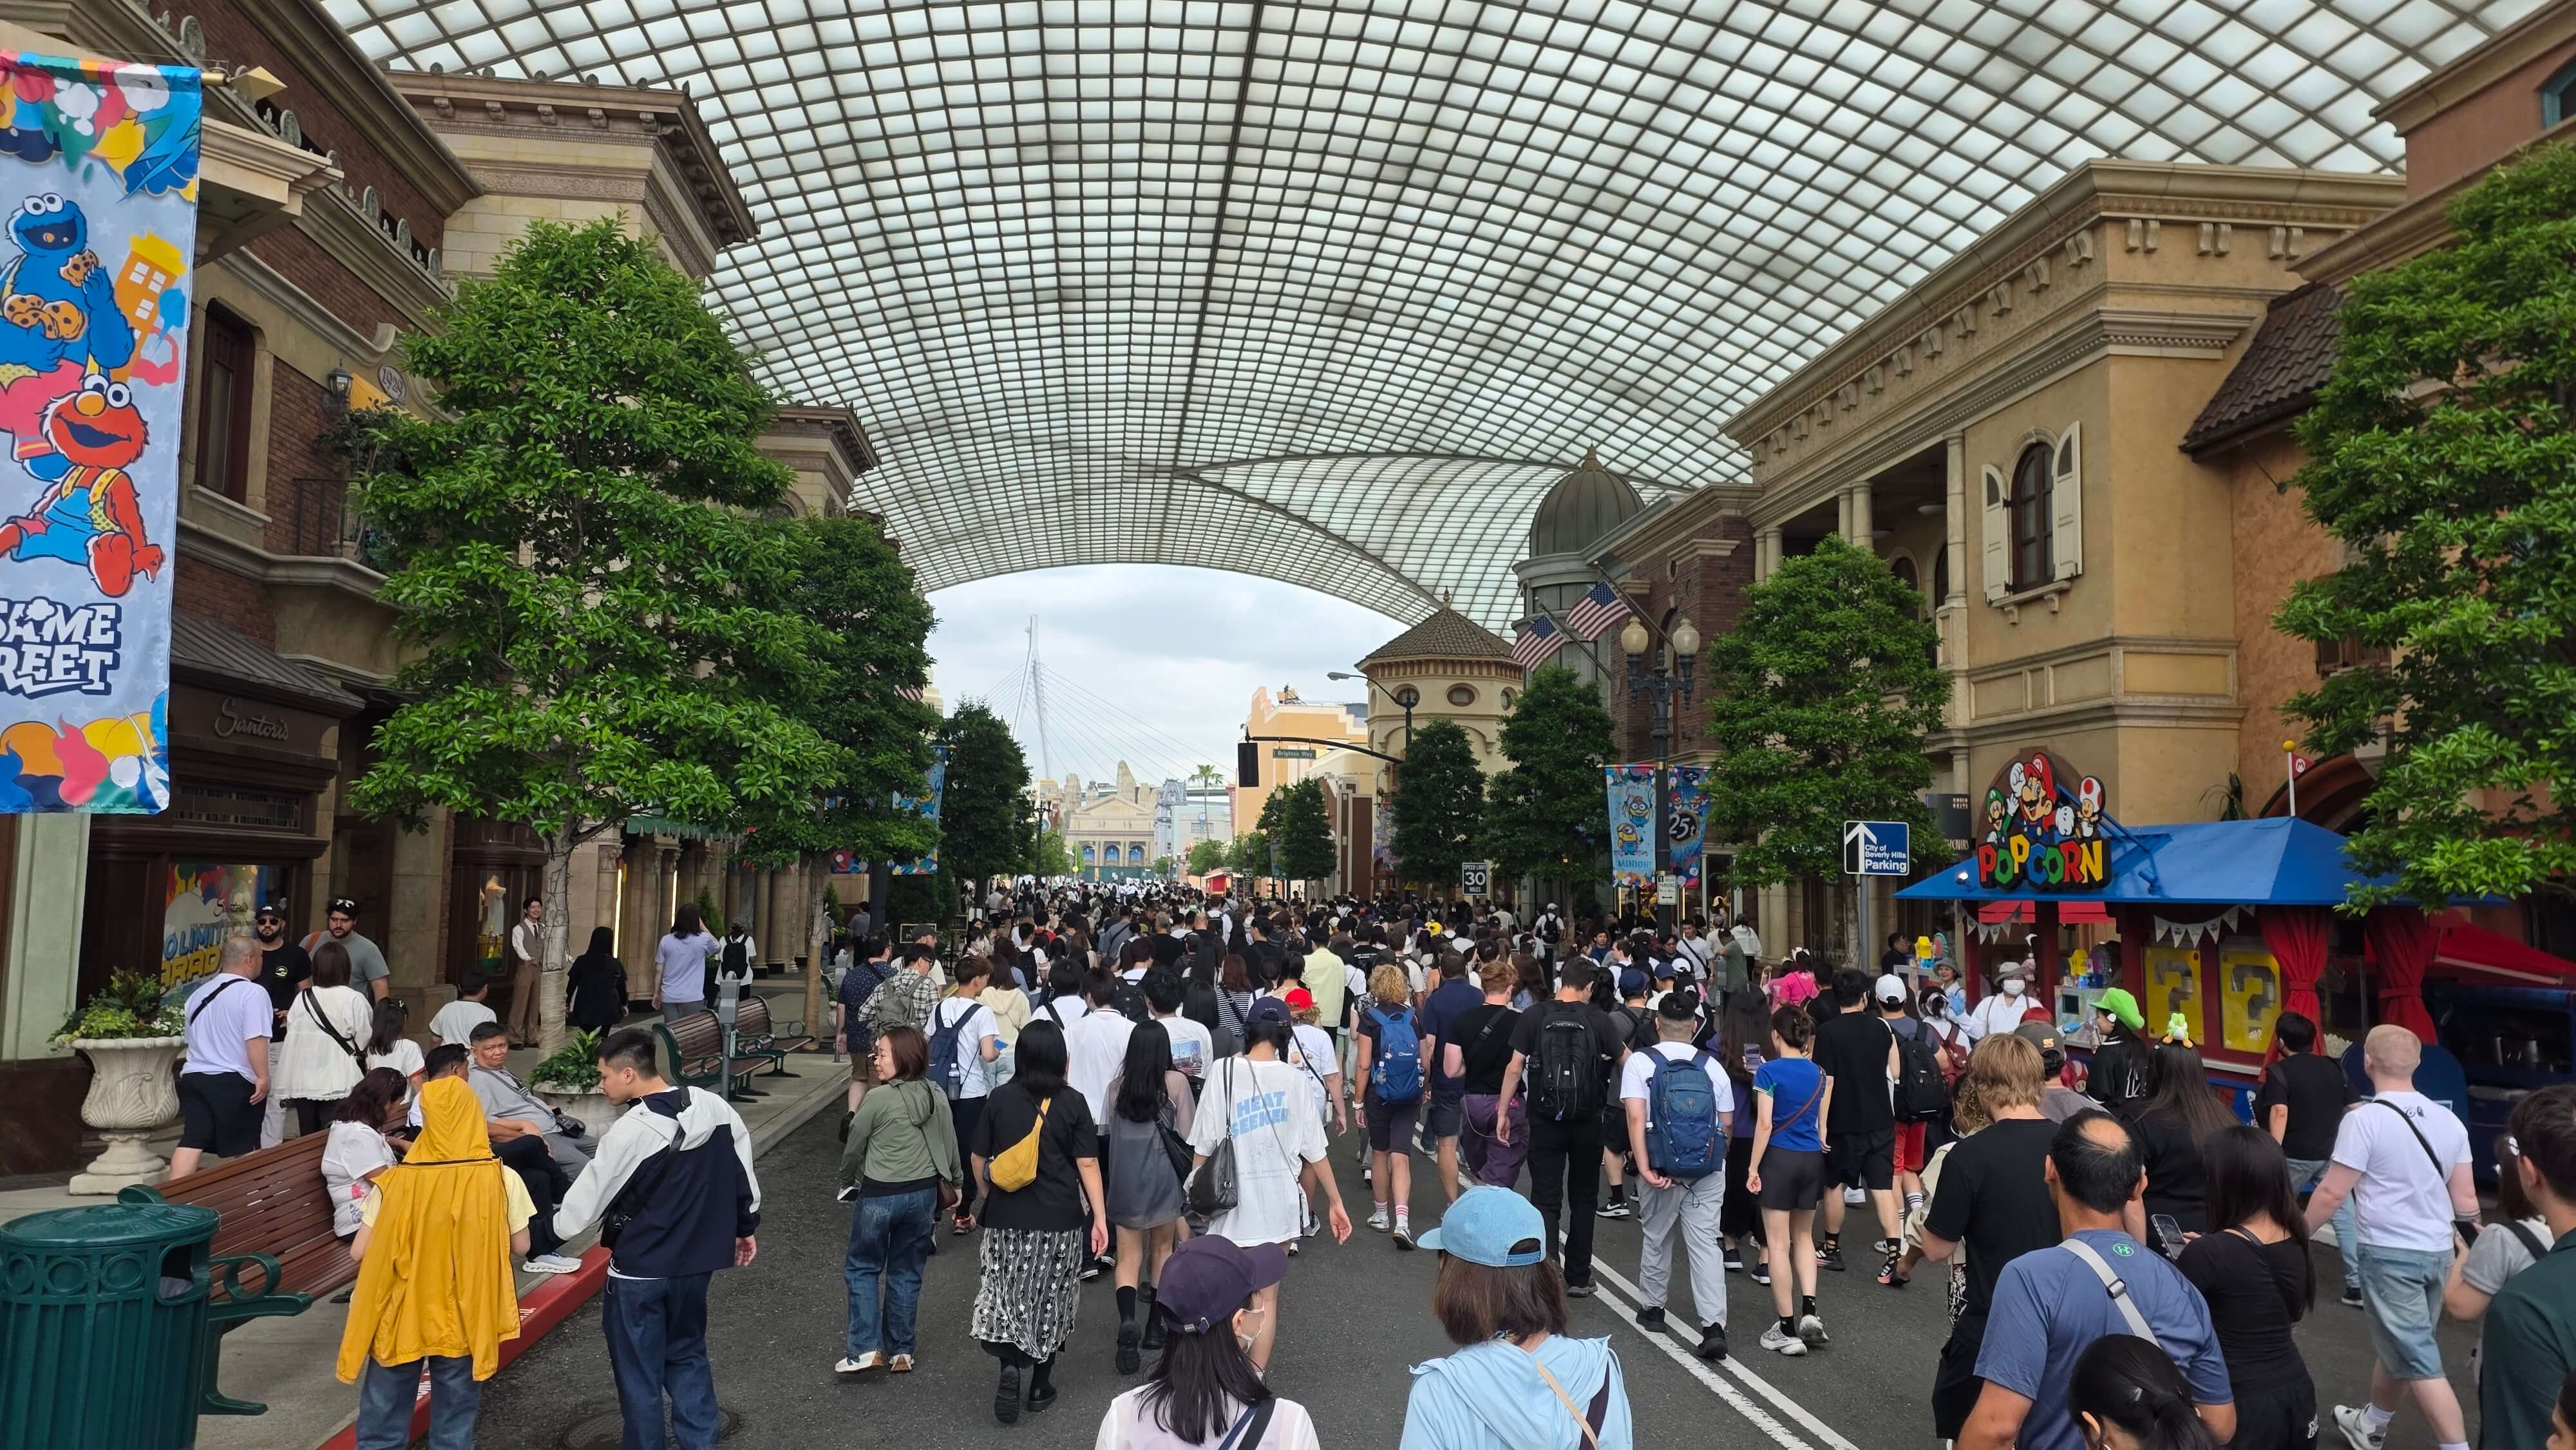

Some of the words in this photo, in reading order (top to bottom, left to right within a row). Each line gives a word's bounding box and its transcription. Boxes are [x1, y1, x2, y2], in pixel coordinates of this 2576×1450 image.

[1865, 851, 1889, 860] Beverly
[1978, 834, 2103, 885] POPCORN
[1865, 860, 1907, 873] Parking
[1464, 872, 1486, 885] 30
[1236, 1091, 1285, 1118] HEAT
[1231, 1107, 1289, 1139] SEEKER
